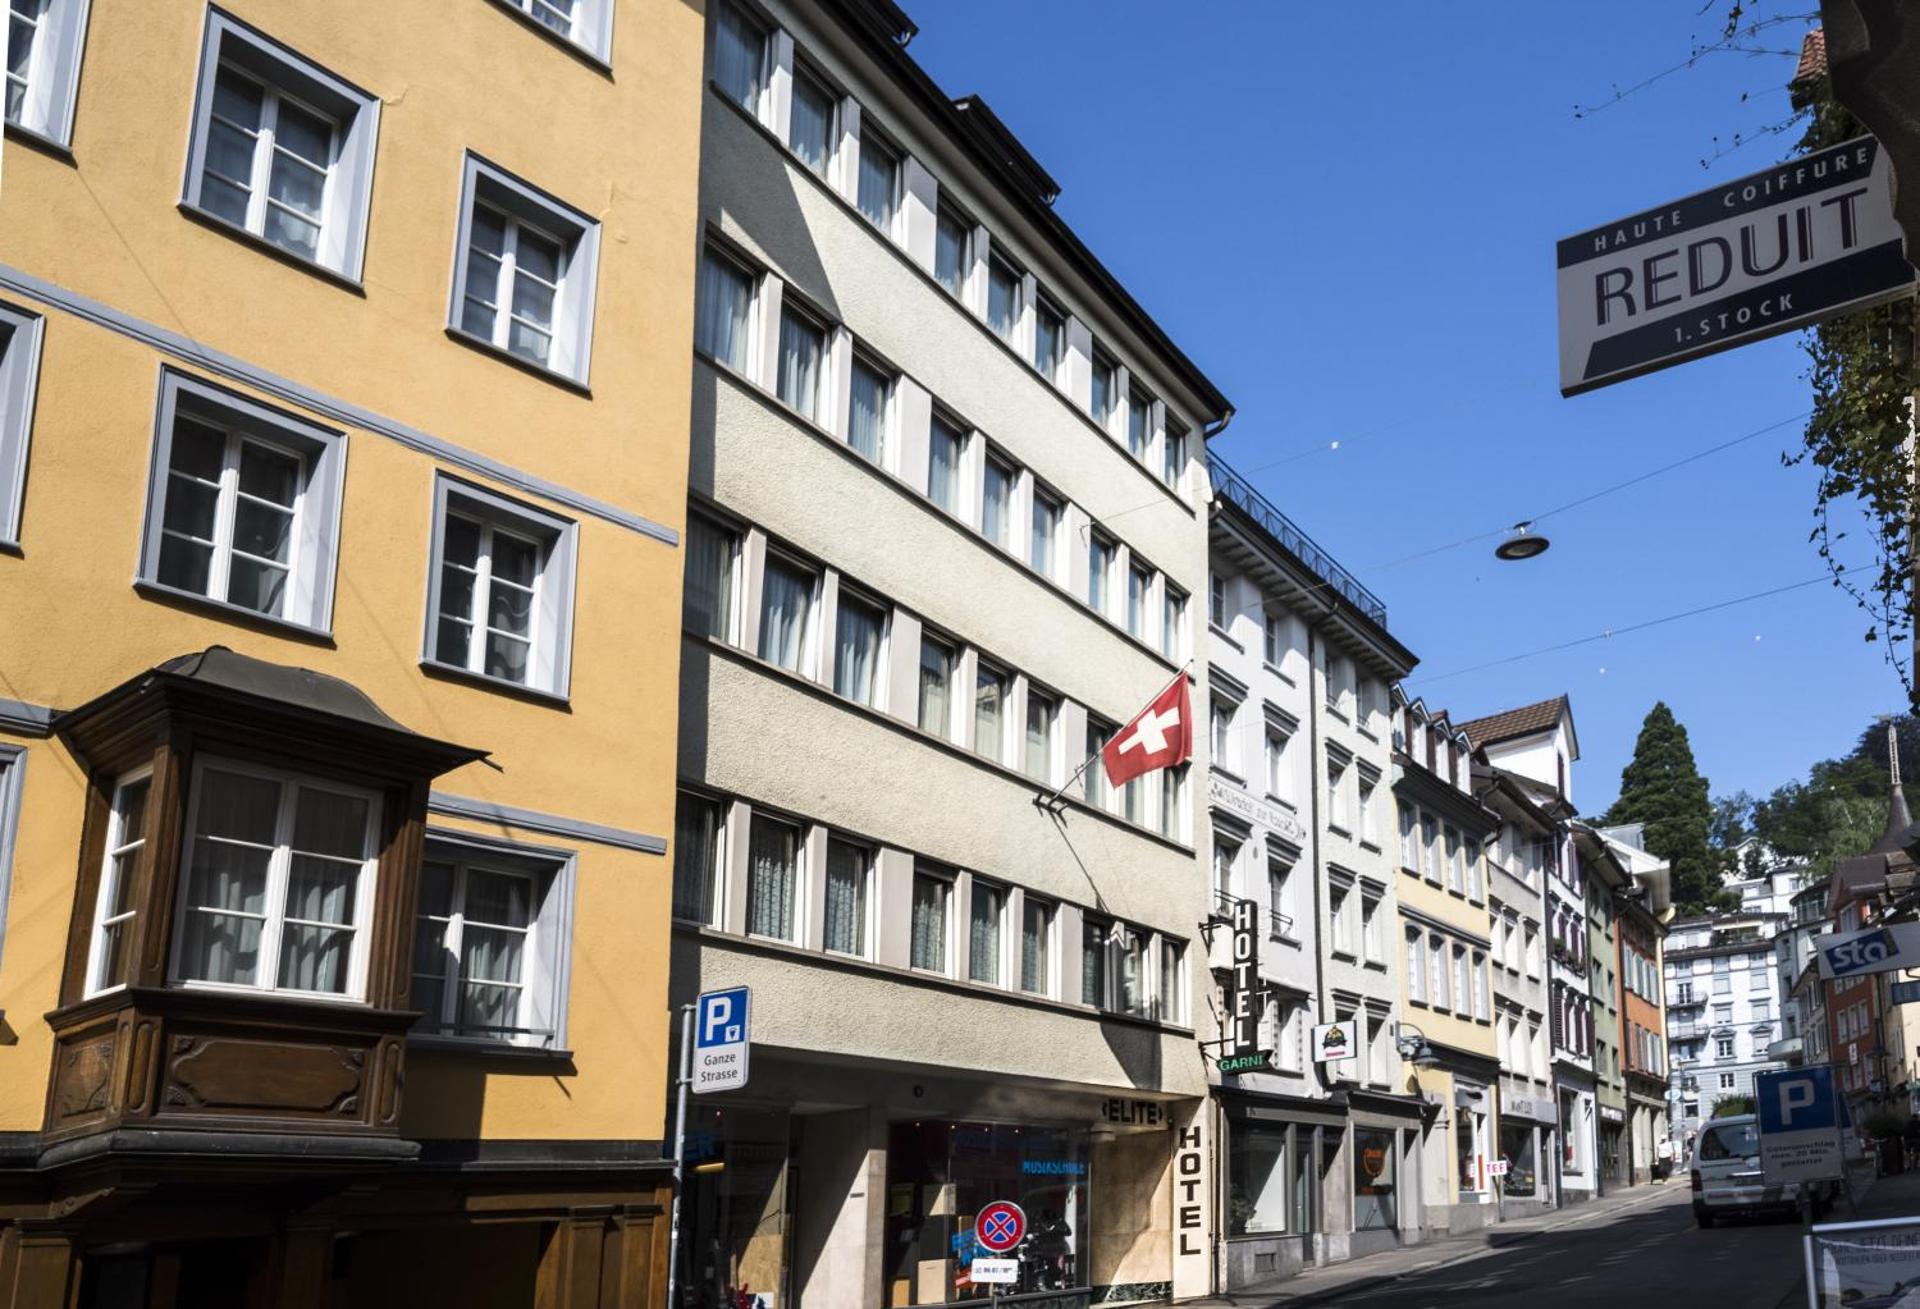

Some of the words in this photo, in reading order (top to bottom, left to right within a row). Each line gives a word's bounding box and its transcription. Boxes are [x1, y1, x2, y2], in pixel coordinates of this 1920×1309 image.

[1594, 209, 1682, 252] HAUTE
[1723, 146, 1868, 208] COIFFURE
[1595, 187, 1868, 327] REDUIT
[1235, 903, 1251, 1047] HOTEL
[705, 996, 731, 1041] P
[701, 1069, 738, 1083] Strasse
[704, 1054, 737, 1066] Ganze
[1219, 1054, 1264, 1071] GARNI
[1778, 1079, 1815, 1125] P
[1179, 1126, 1201, 1256] HOTEL
